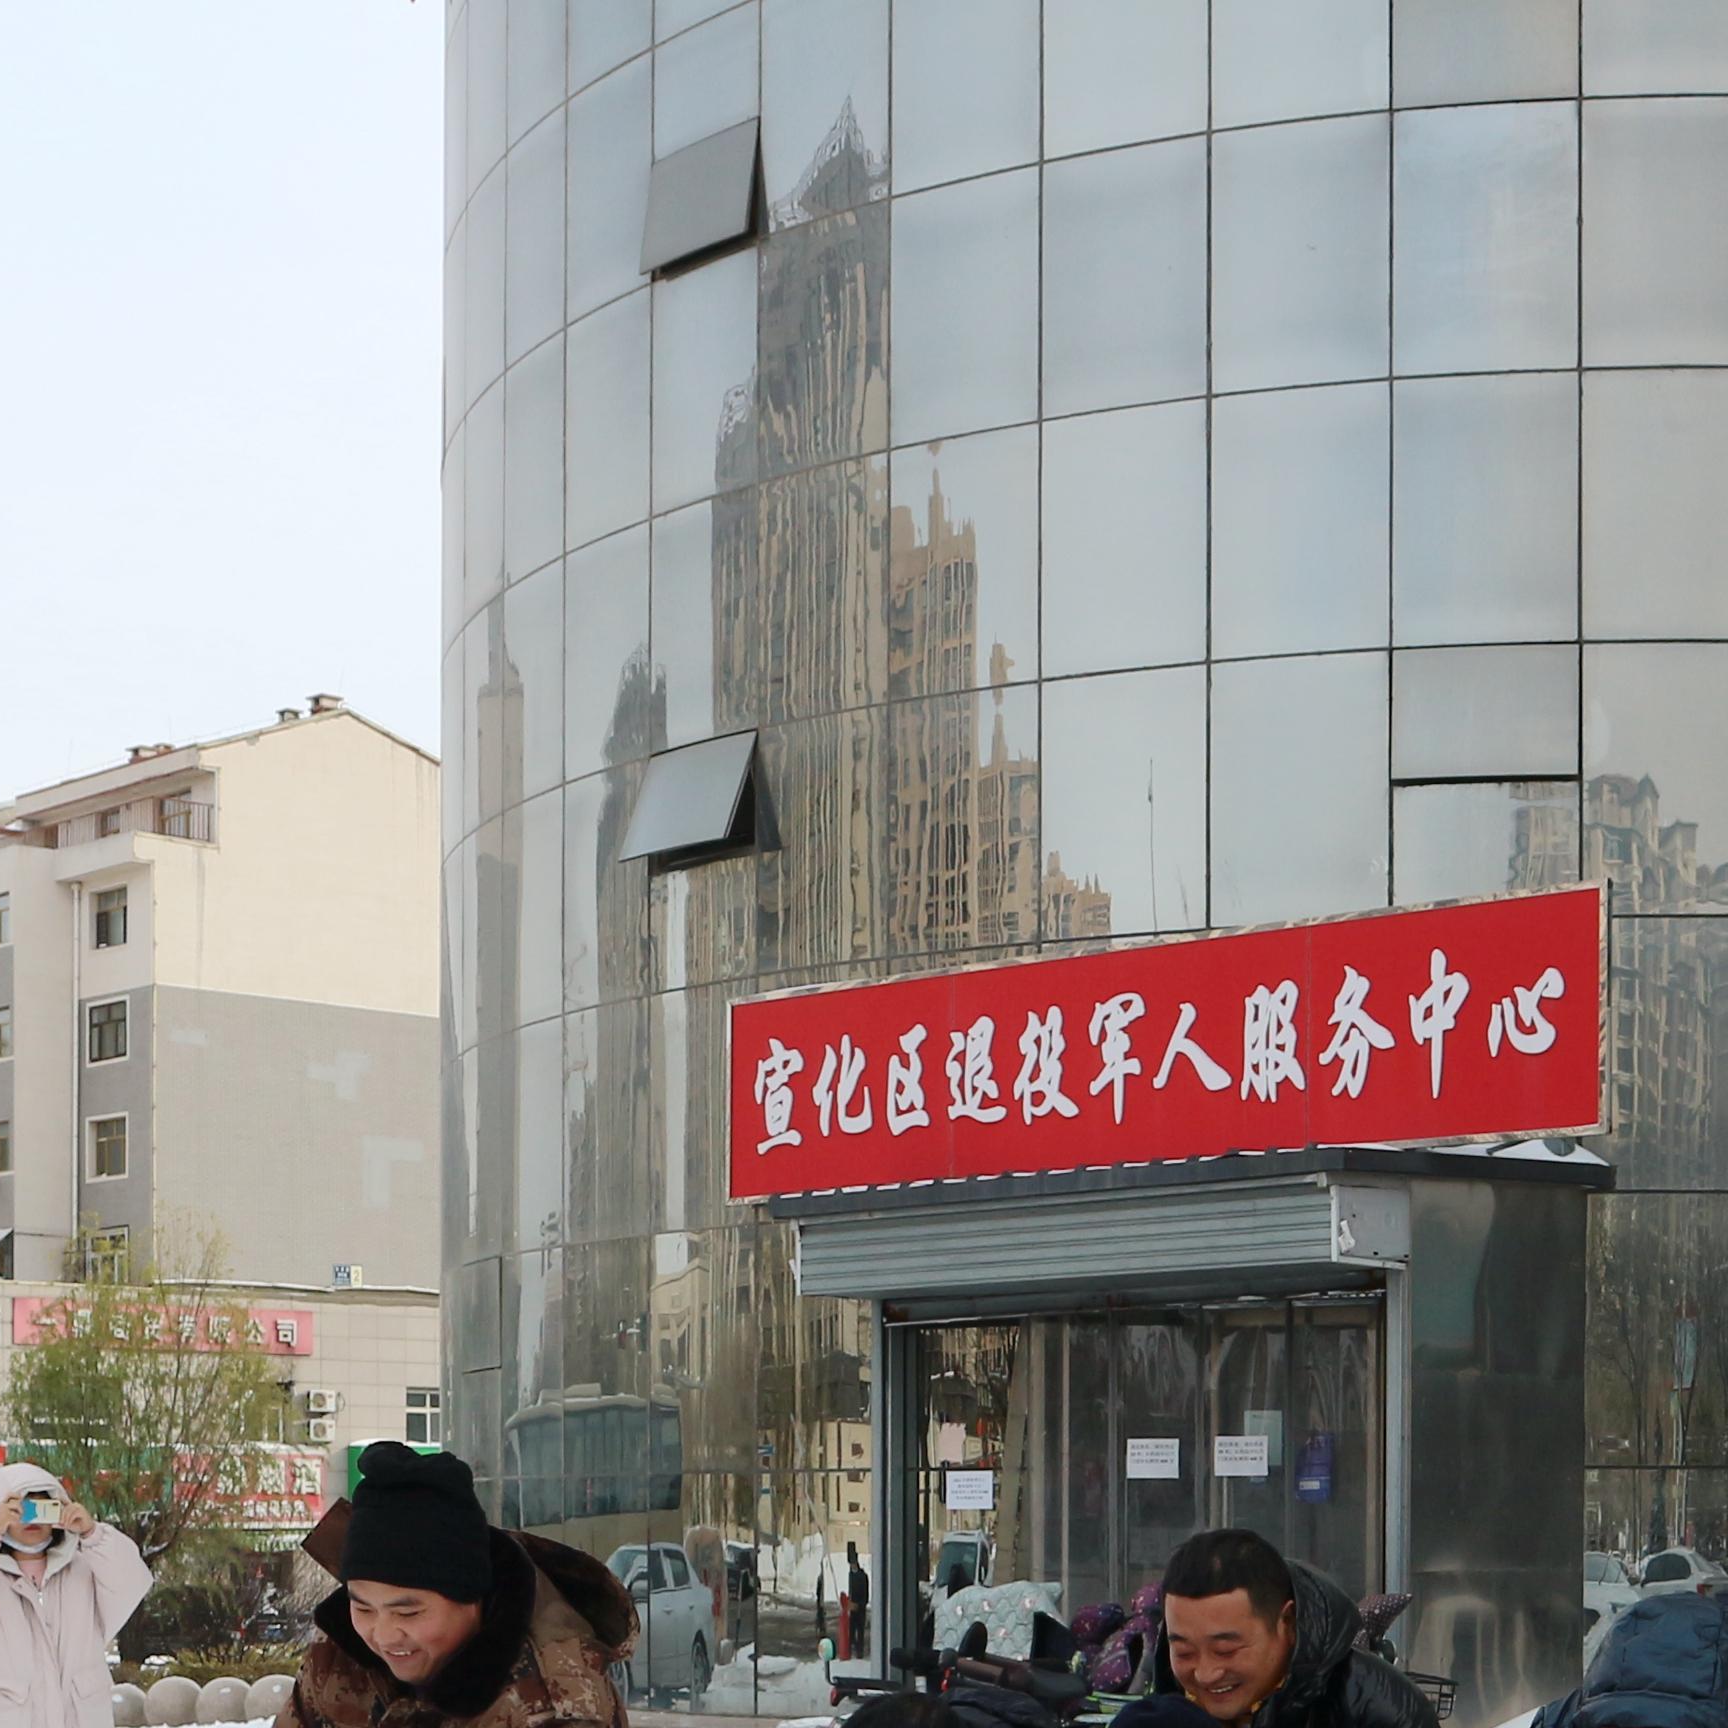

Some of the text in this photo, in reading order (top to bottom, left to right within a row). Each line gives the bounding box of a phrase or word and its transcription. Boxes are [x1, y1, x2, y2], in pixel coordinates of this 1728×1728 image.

[754, 948, 1566, 1155] 宣化区退役军人服务中心
